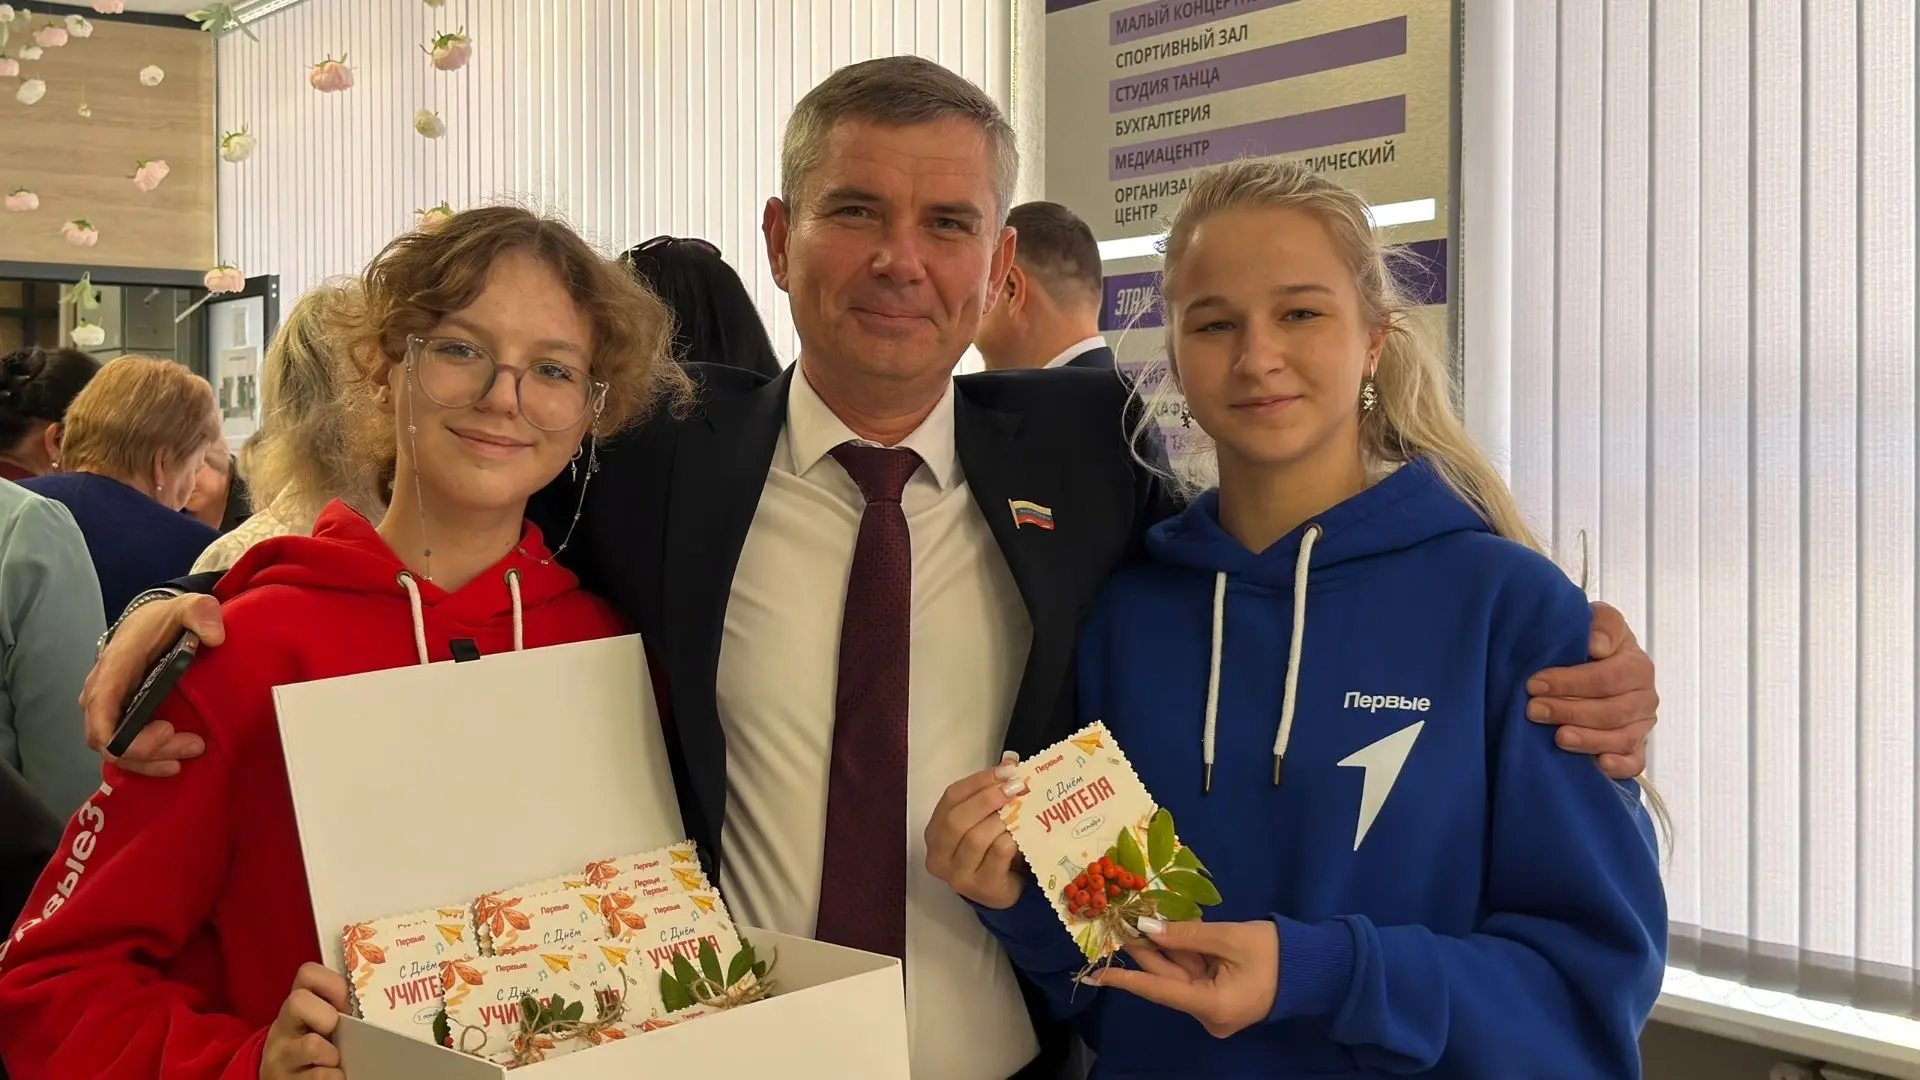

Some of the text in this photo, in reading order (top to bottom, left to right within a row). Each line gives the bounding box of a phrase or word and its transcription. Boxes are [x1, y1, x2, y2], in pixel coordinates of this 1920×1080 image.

[1116, 5, 1170, 35] МАЛЫЙ
[1116, 24, 1248, 68] СПОРТИВНЫЙ ЗАЛ
[1115, 67, 1220, 102] СТУДИЯ ТАНЦА
[1115, 104, 1211, 136] БУХГАЛТЕРИЯ
[1115, 139, 1210, 171] МЕДИАЦЕНТР
[1114, 177, 1192, 203] ОРГАНИЗА
[1115, 204, 1158, 226] ЦЕНТР
[1343, 691, 1431, 713] Первые
[1035, 754, 1064, 773] Первые
[1046, 776, 1084, 801] С Днём
[1035, 776, 1115, 833] УЧИТЕЛЯ
[540, 904, 570, 915] Первые
[654, 904, 681, 915] Первые
[396, 935, 426, 947] Первые
[543, 929, 581, 944] С Днём
[660, 927, 696, 942] С Днём
[647, 935, 722, 969] УЧИТЕЯ
[400, 961, 438, 978] С Днём
[496, 963, 528, 973] Первые
[384, 975, 442, 1010] УЧИТЕ
[496, 986, 539, 1001] С Днём
